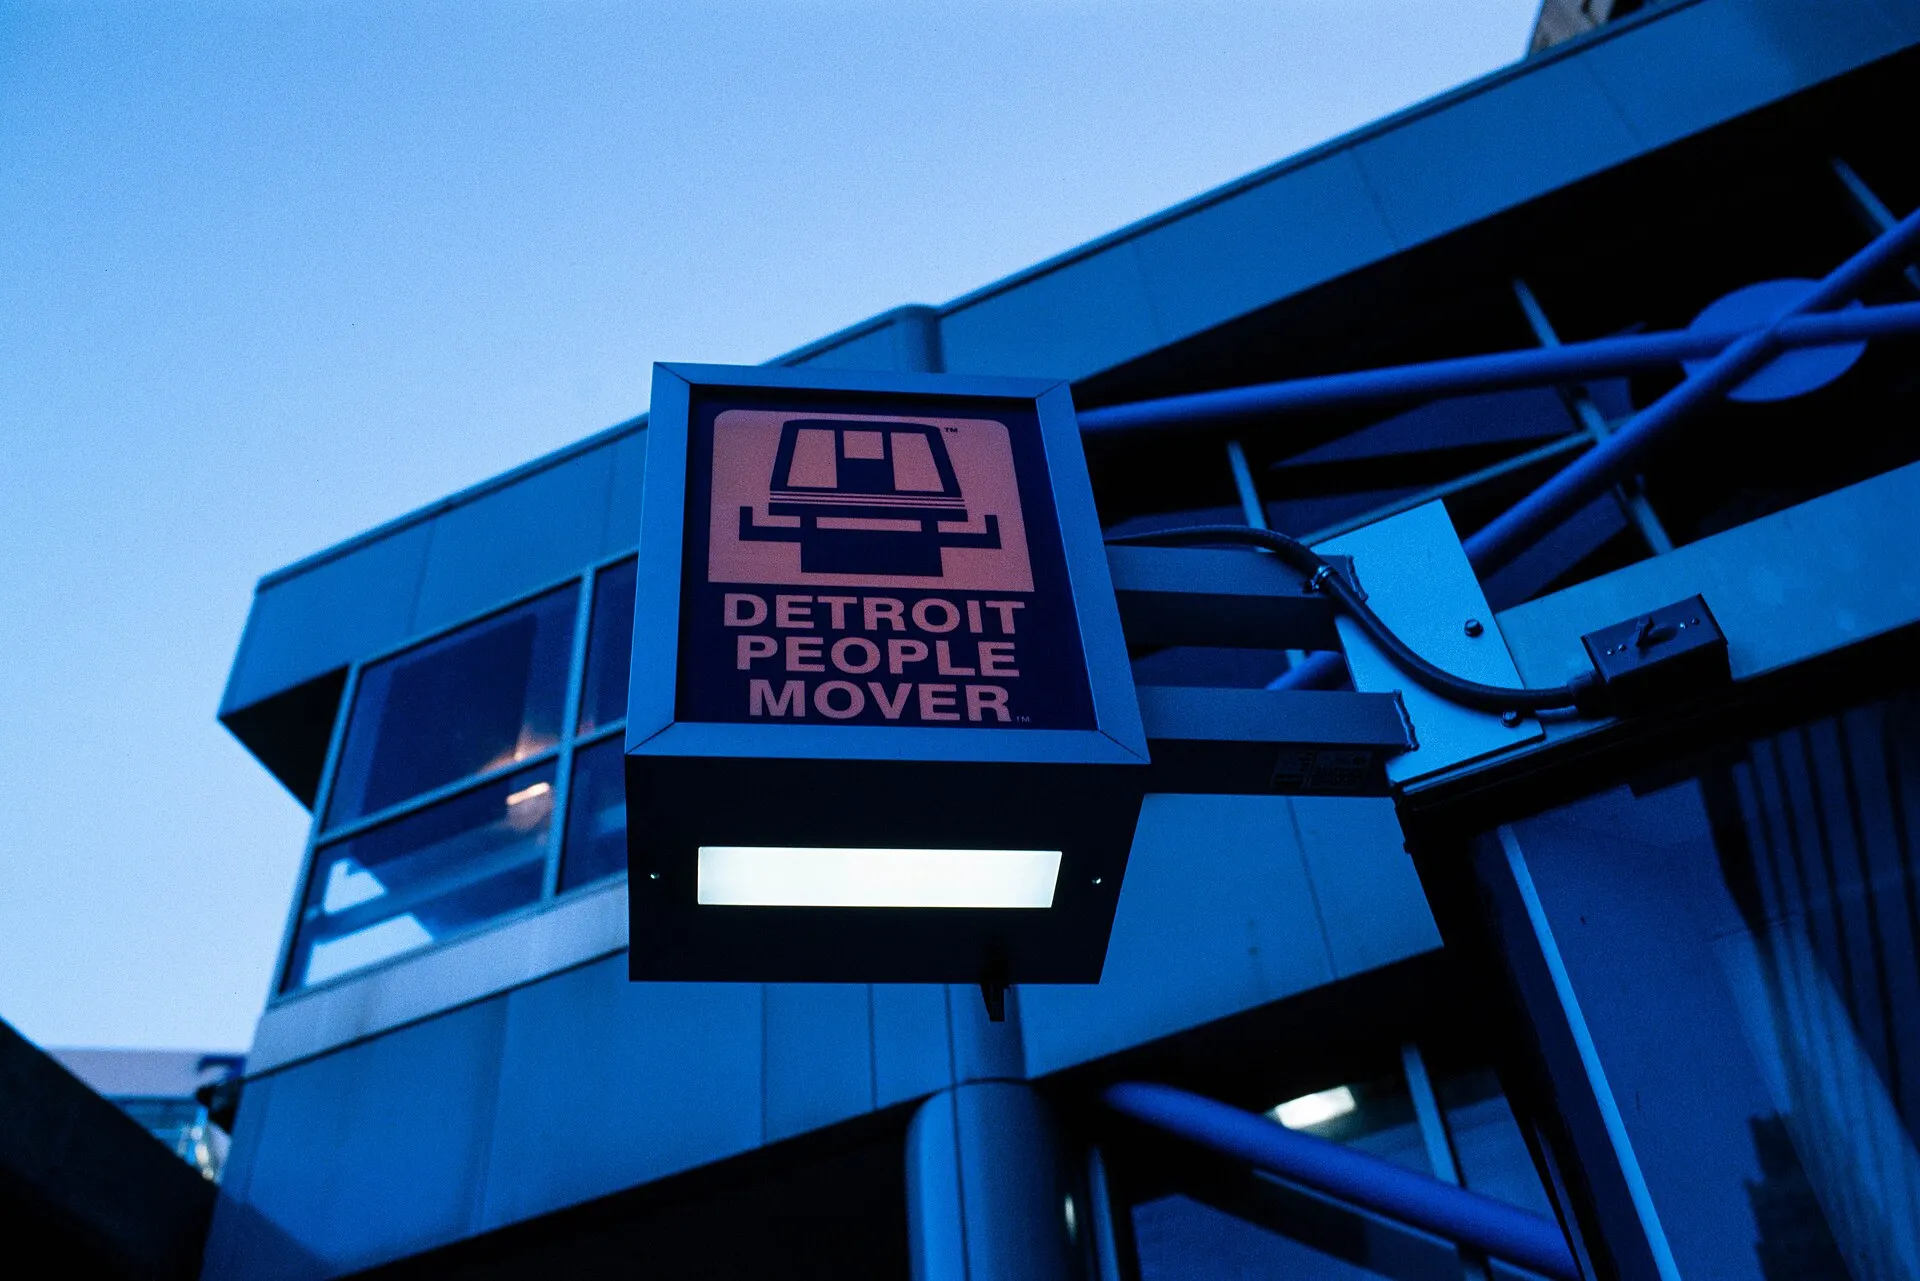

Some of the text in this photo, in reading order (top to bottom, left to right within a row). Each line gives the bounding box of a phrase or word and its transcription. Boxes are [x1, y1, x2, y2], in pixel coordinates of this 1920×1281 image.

[723, 593, 1025, 635] DETROIT
[736, 634, 1020, 678] PEOPLE
[749, 678, 1012, 722] MOVER
